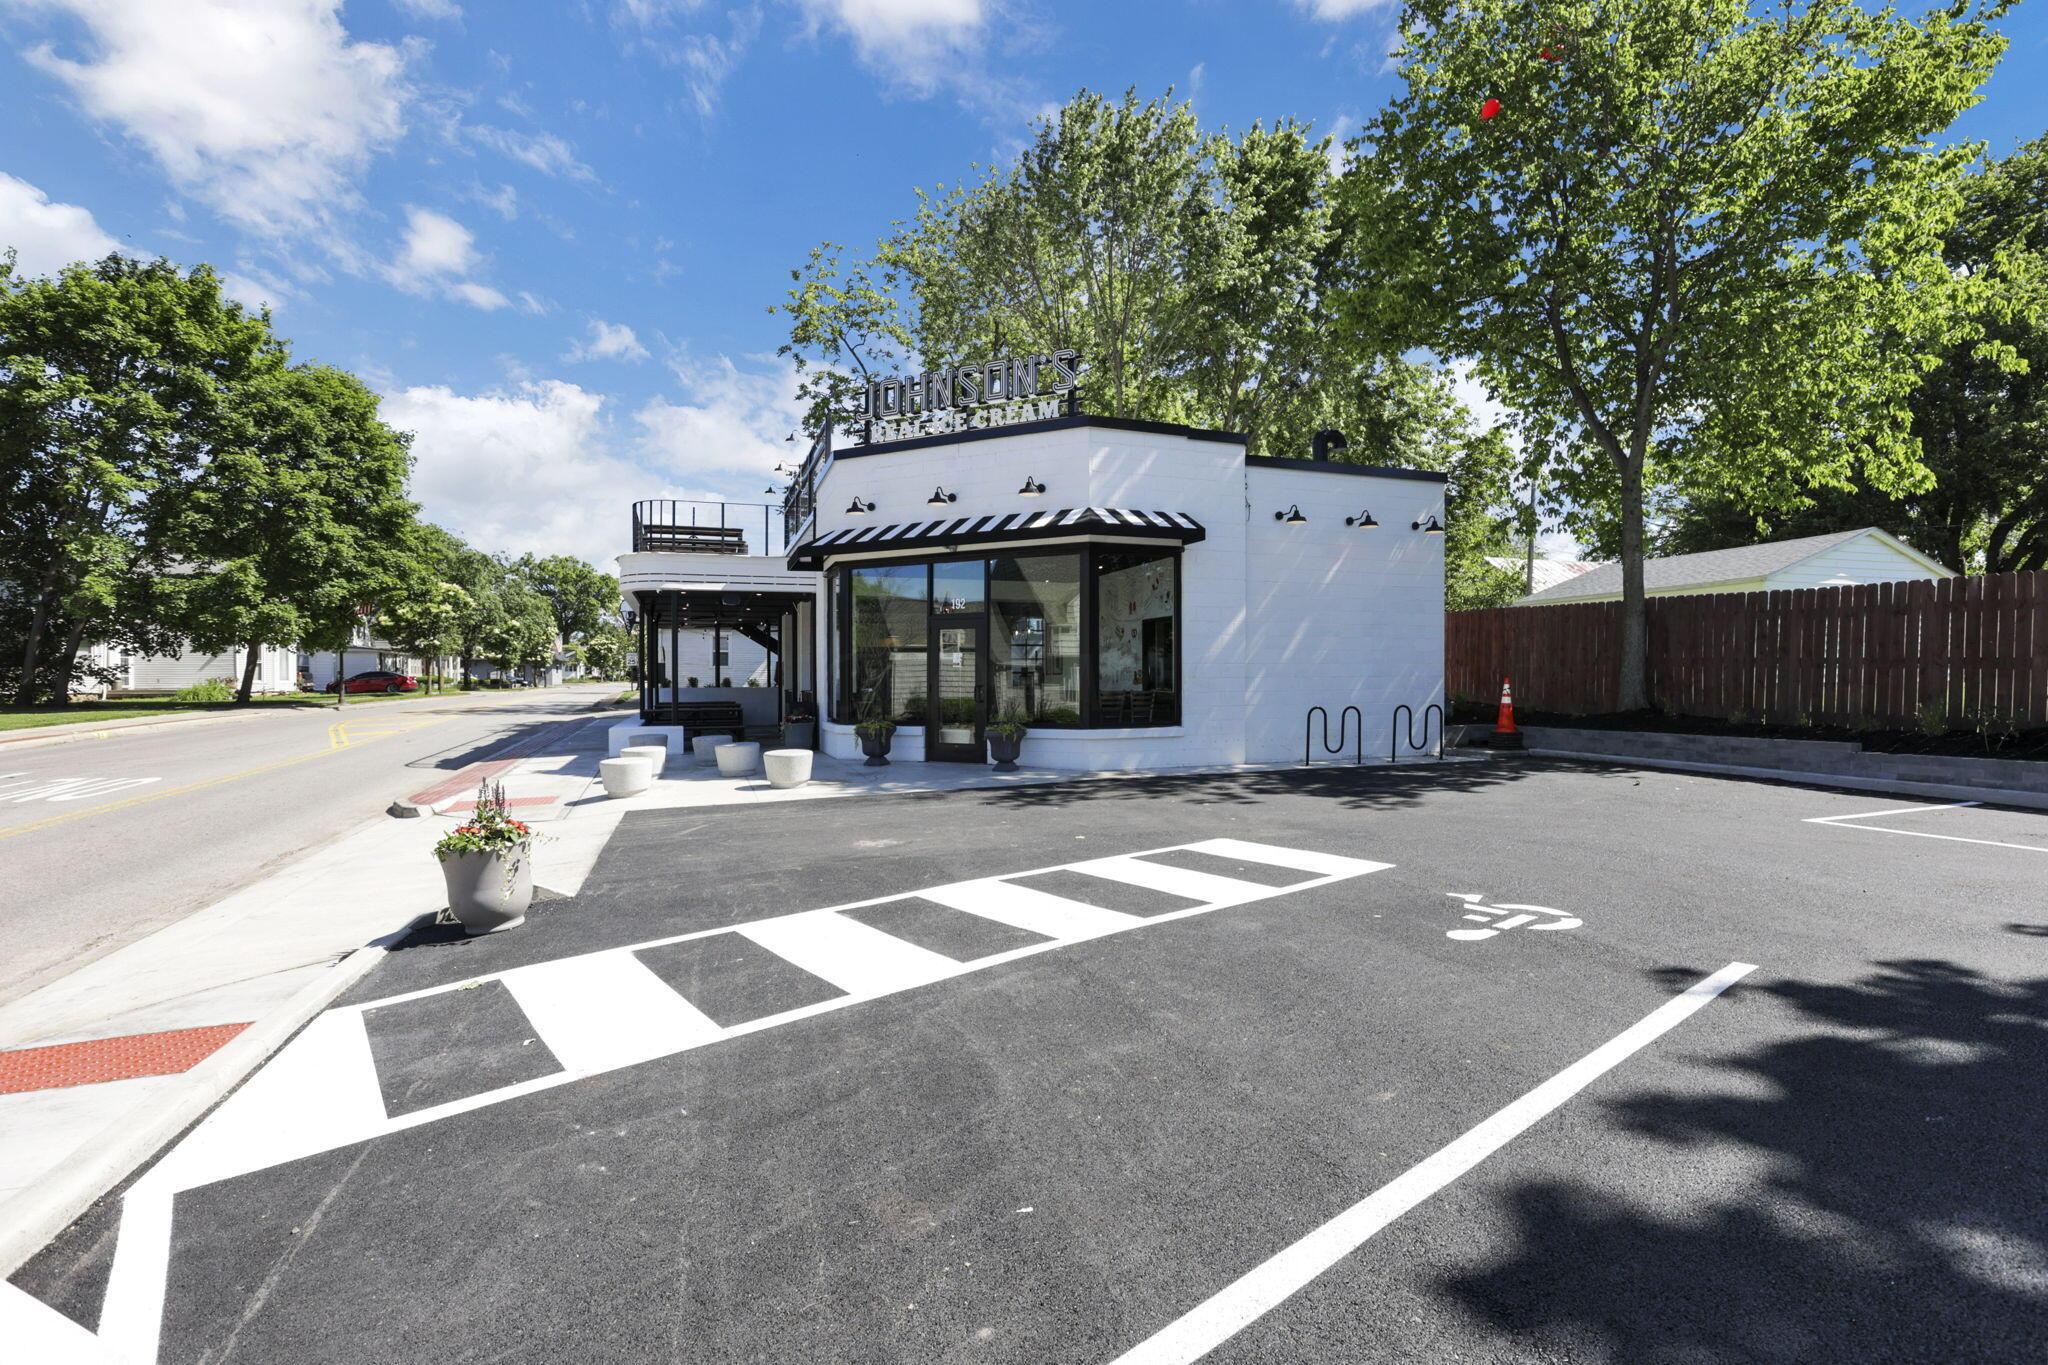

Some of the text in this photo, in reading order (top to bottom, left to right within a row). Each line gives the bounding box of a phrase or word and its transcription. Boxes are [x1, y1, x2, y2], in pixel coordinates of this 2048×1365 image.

[855, 349, 1076, 422] JOHNSON'S
[871, 399, 1060, 443] REAL ICE CREAM
[951, 598, 966, 610] 192
